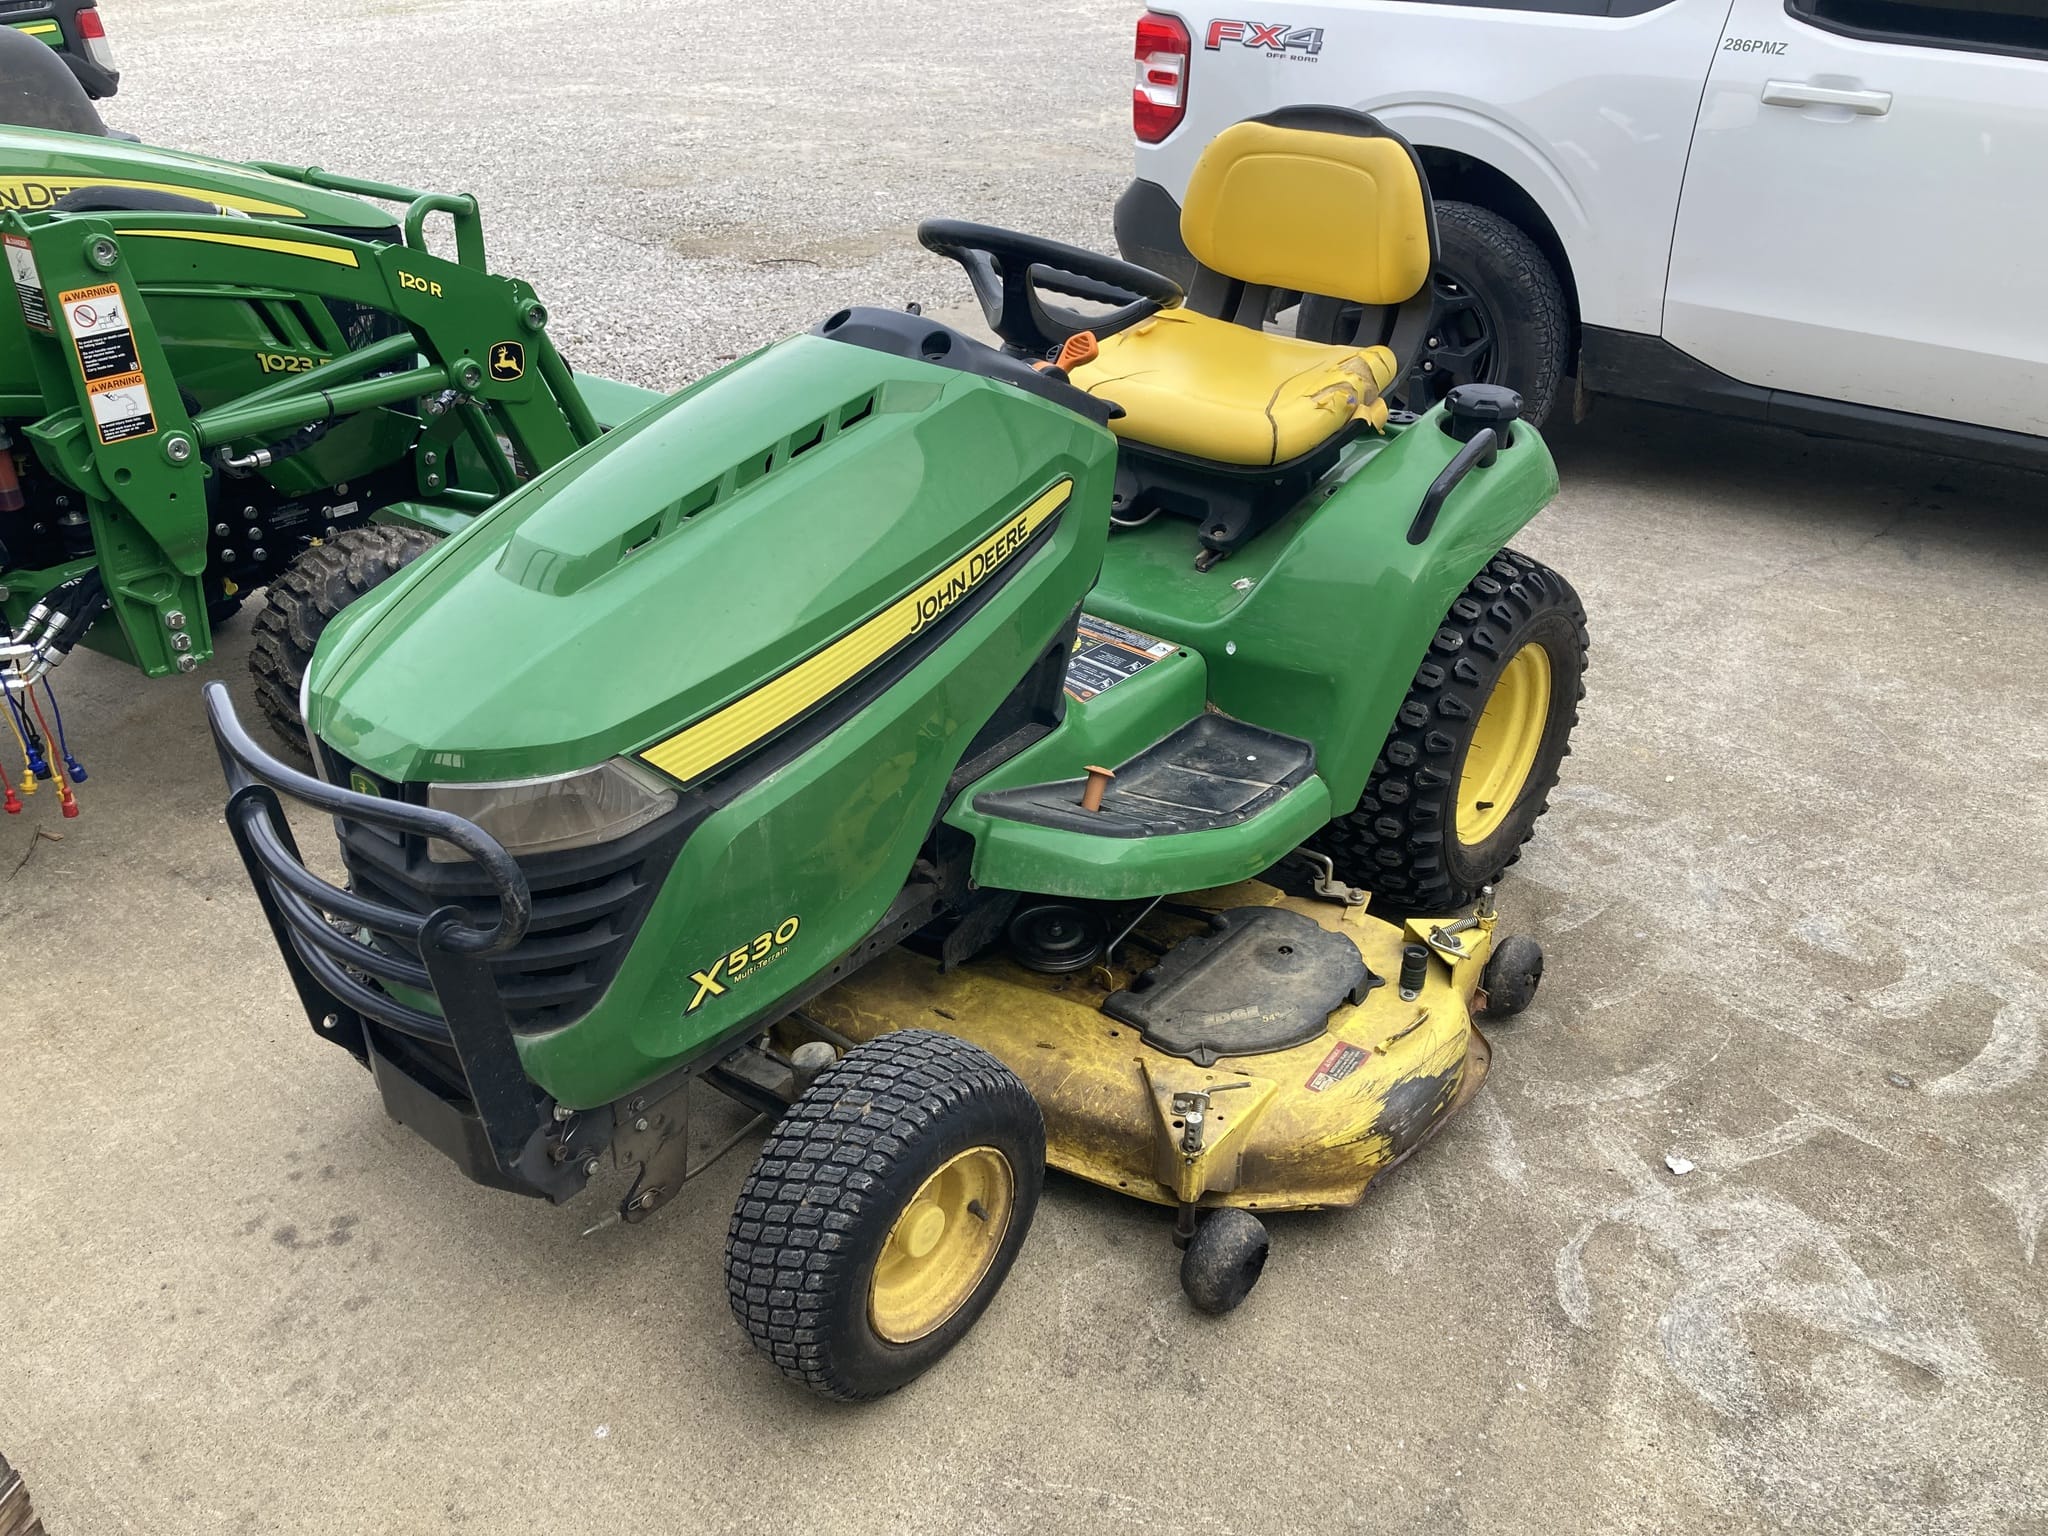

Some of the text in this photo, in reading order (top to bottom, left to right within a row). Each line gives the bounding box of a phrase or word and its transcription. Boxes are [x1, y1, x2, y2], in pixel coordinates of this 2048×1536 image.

[1205, 18, 1325, 55] FX4
[1723, 37, 1788, 56] 286PMZ
[1266, 52, 1318, 63] OFF ROAD
[23, 183, 80, 206] DE
[71, 285, 117, 301] WARNING
[398, 270, 442, 298] 120 R
[256, 353, 314, 373] 1023
[99, 375, 142, 391] WARNING
[911, 517, 1029, 633] JOHN DEERE
[682, 915, 801, 1017] X530
[734, 946, 788, 983] Multi-Terrain
